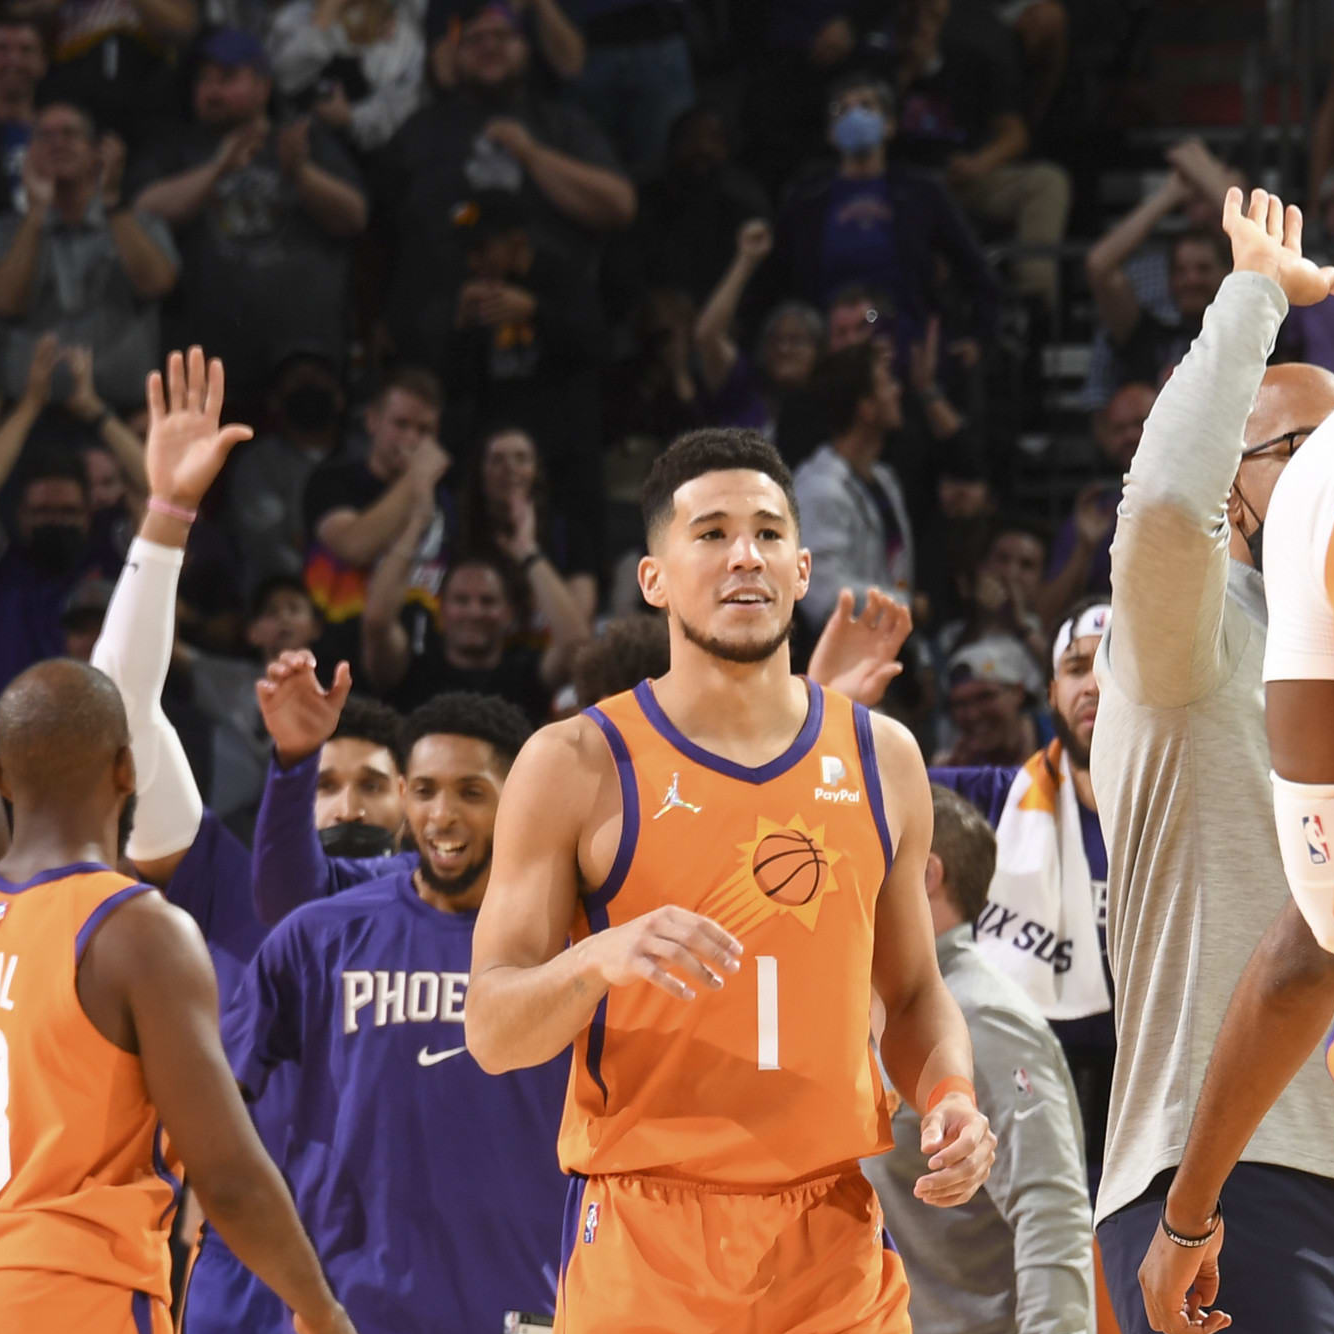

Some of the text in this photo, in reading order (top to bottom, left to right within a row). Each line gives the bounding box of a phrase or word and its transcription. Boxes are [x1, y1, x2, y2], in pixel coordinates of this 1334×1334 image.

[814, 788, 860, 803] PayPal
[342, 970, 469, 1034] PHOE
[755, 955, 781, 1071] 1
